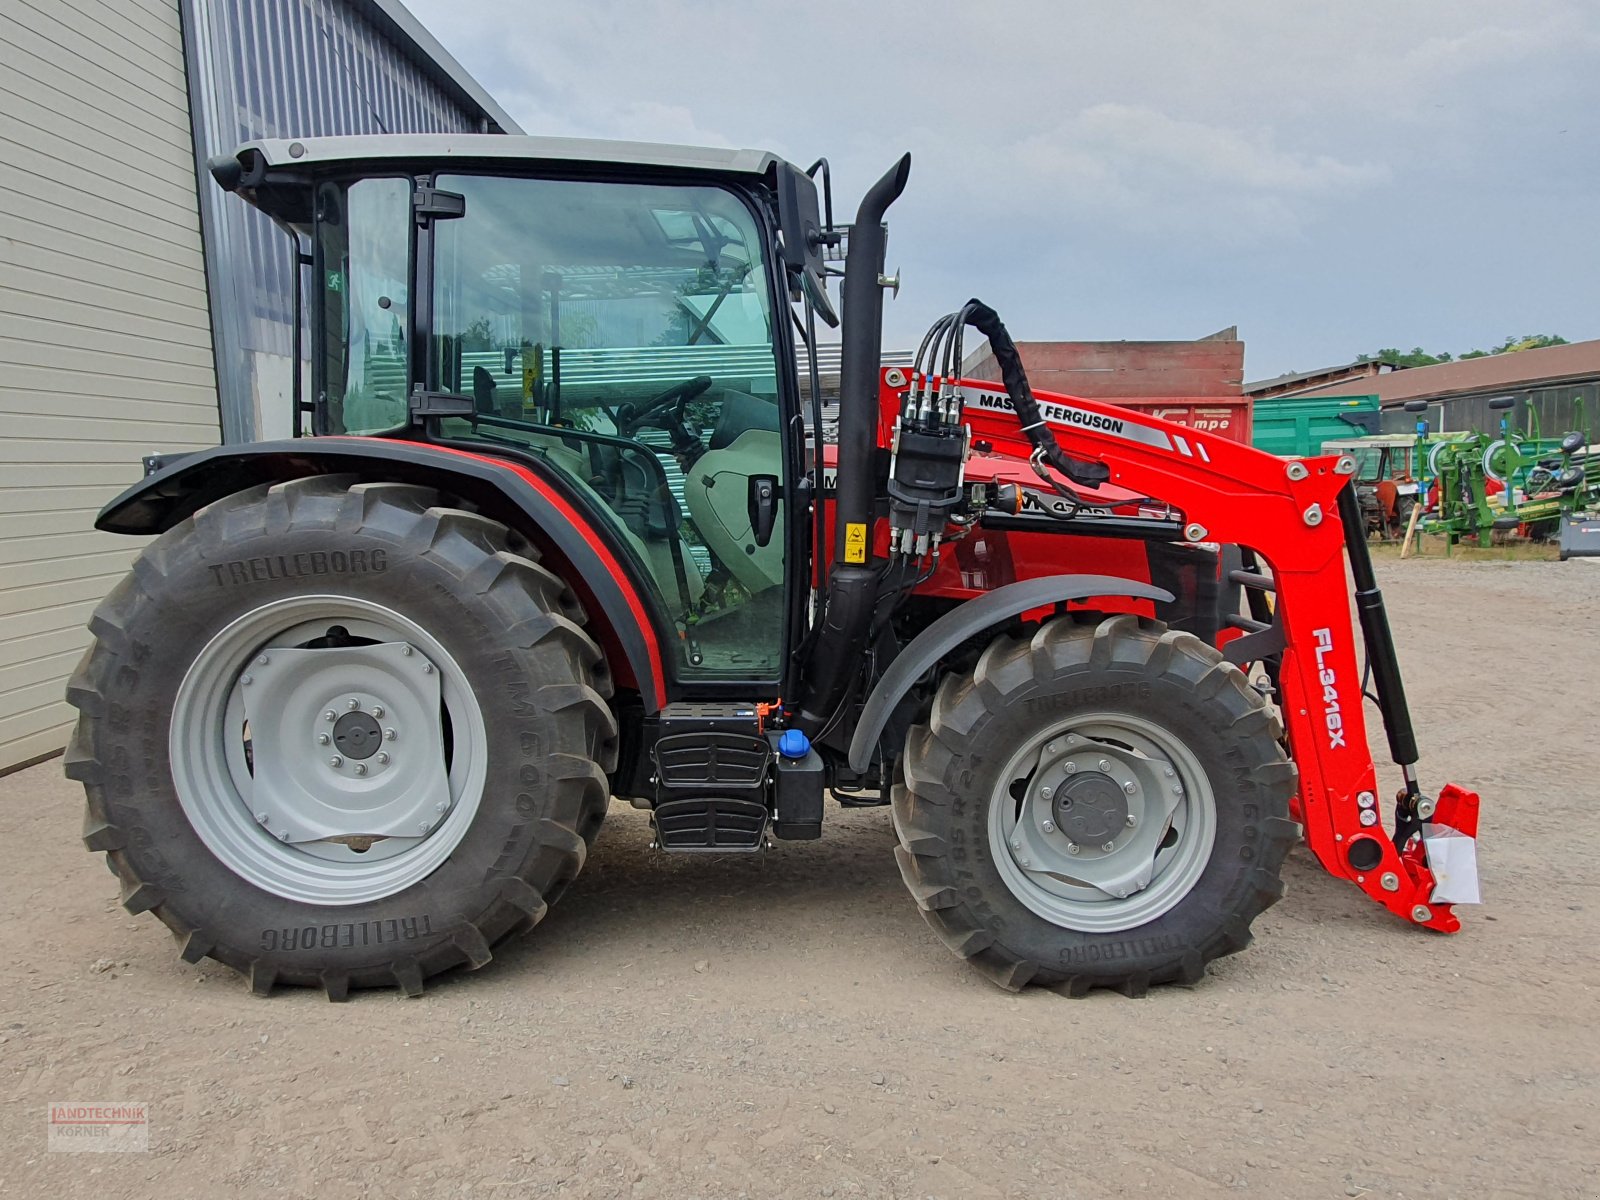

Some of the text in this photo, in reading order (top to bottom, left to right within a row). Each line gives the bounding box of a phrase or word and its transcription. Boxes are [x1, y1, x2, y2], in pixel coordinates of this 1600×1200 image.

[979, 394, 1124, 434] MAS FERGUSON
[208, 548, 388, 587] TRELLEBORG
[1312, 627, 1346, 749] FL.3416X
[261, 914, 438, 952] TRELLEBORG
